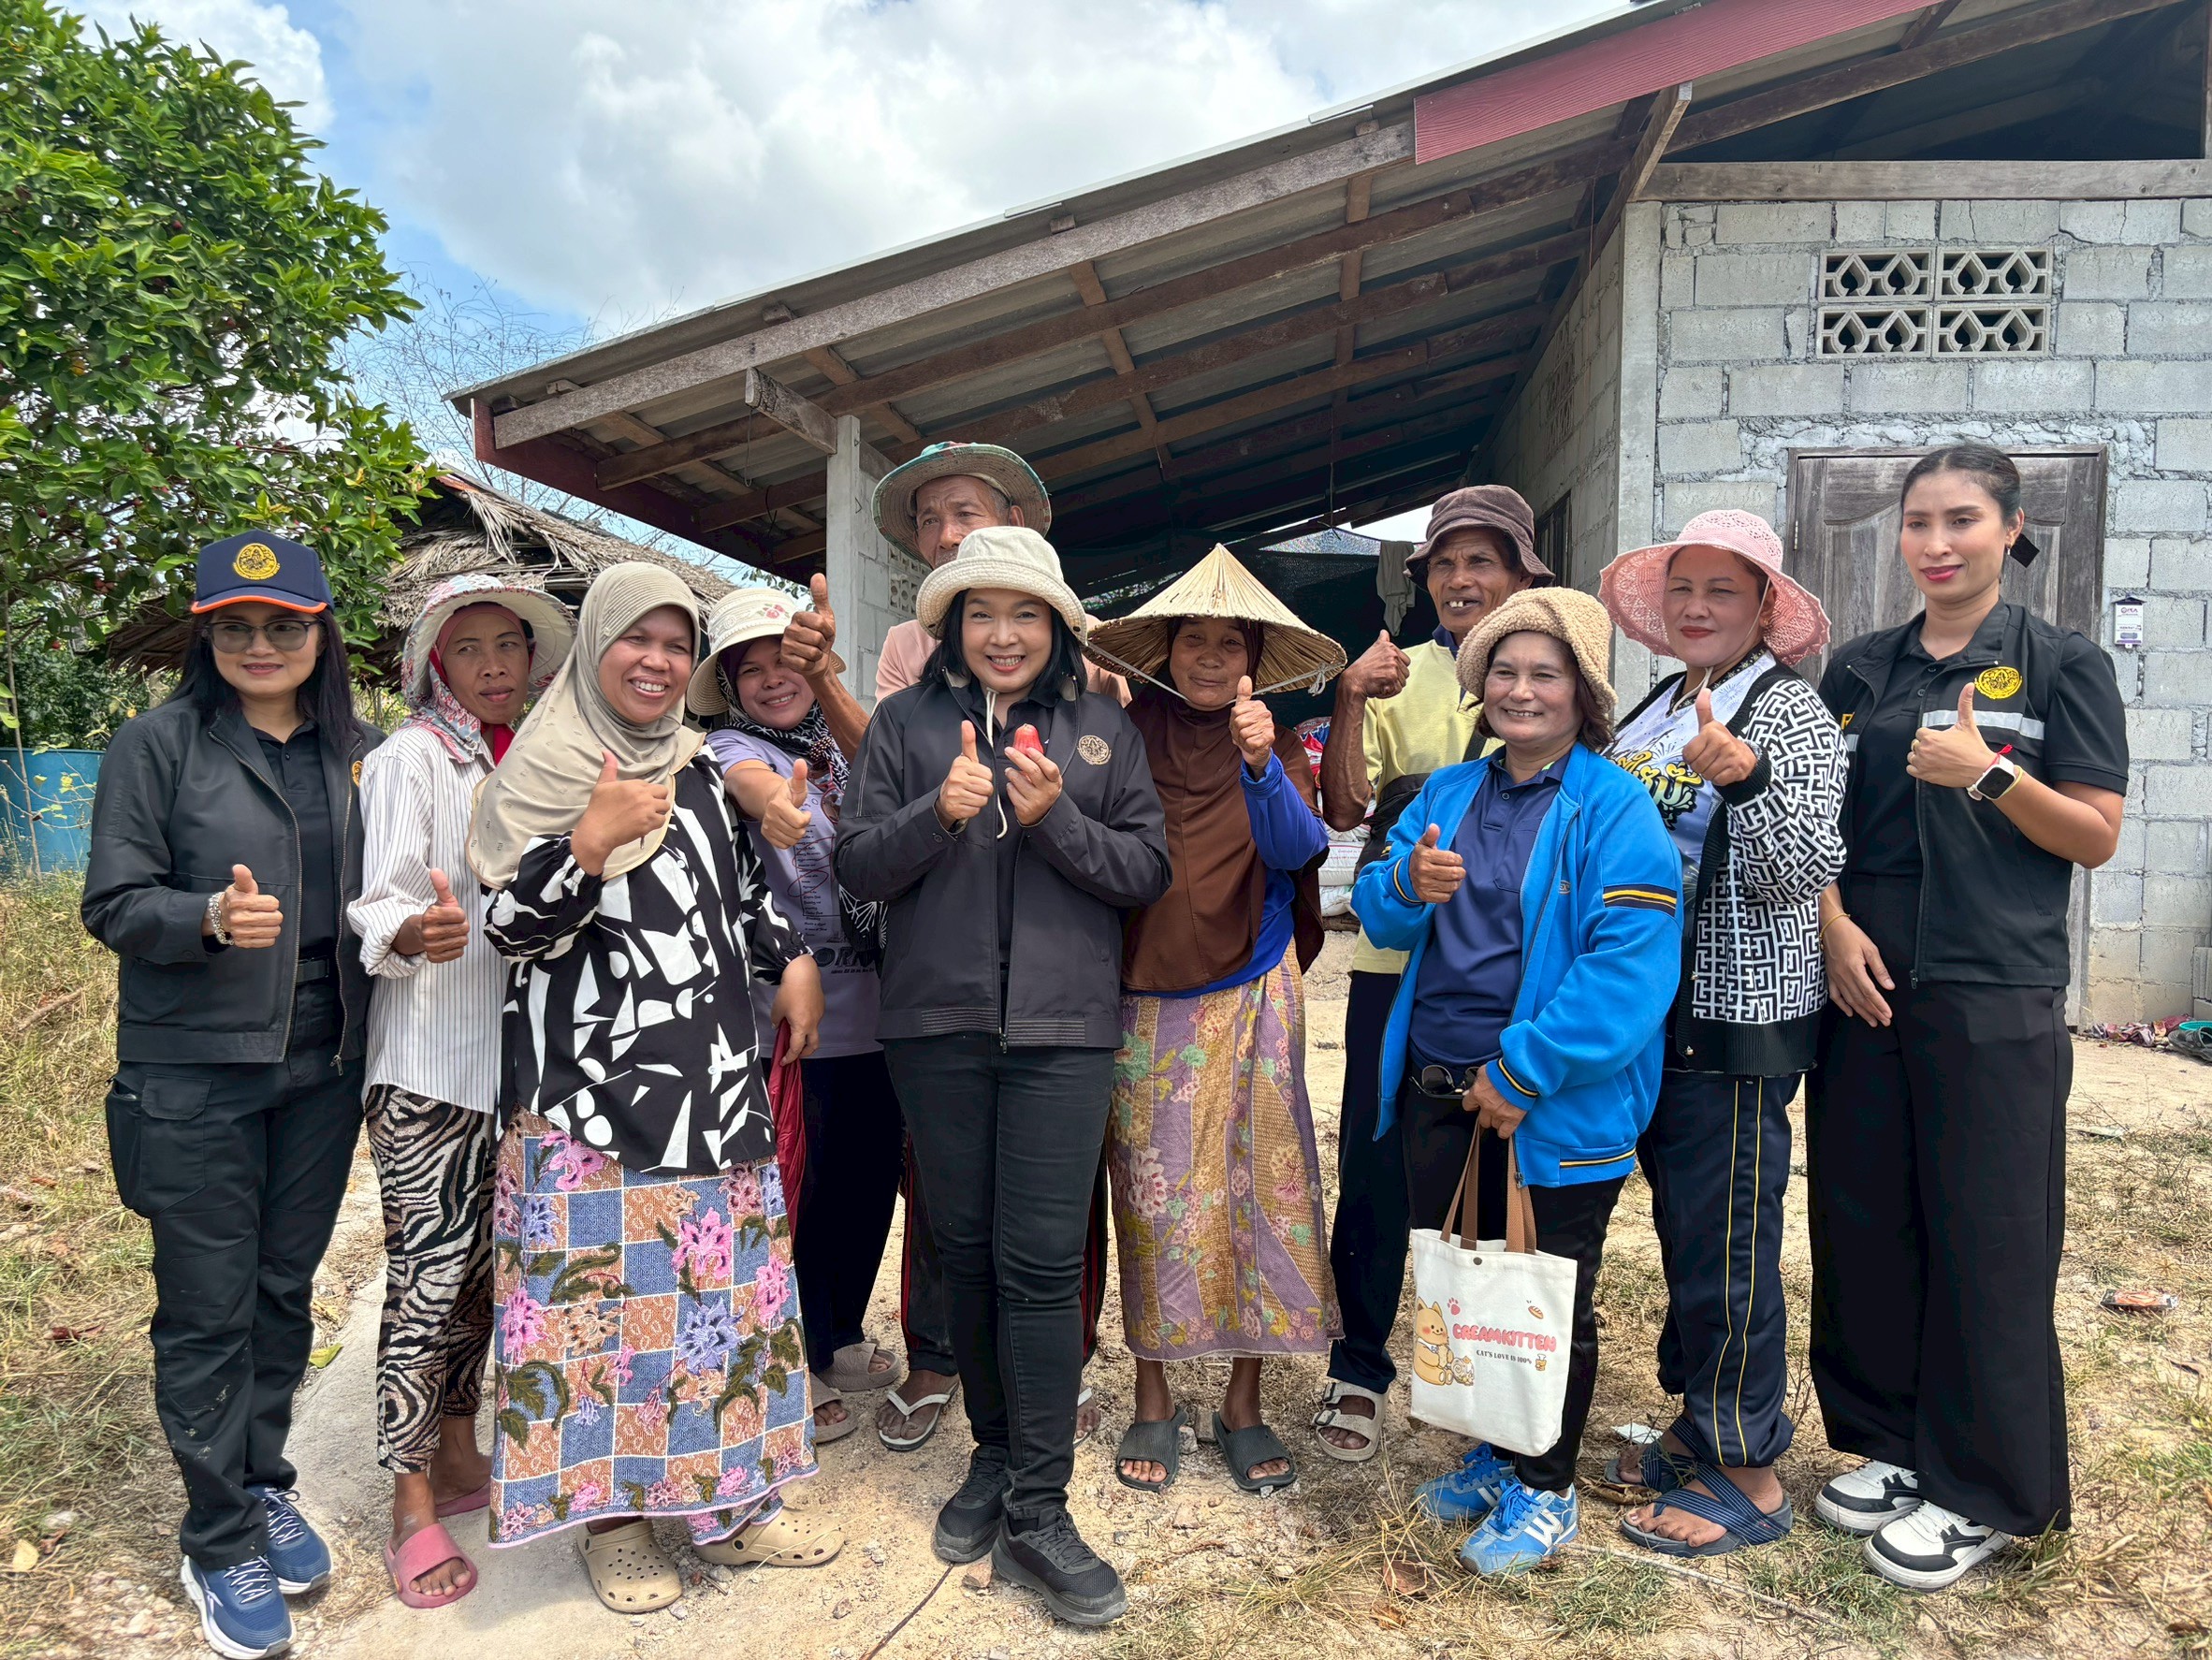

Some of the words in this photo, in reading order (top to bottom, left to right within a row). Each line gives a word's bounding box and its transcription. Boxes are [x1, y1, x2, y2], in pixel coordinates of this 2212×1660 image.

[1452, 1323, 1557, 1352] CREAMKITTEN
[1476, 1349, 1492, 1358] CAT'S
[1493, 1352, 1509, 1361] LOVE
[1517, 1356, 1532, 1364] 100%
